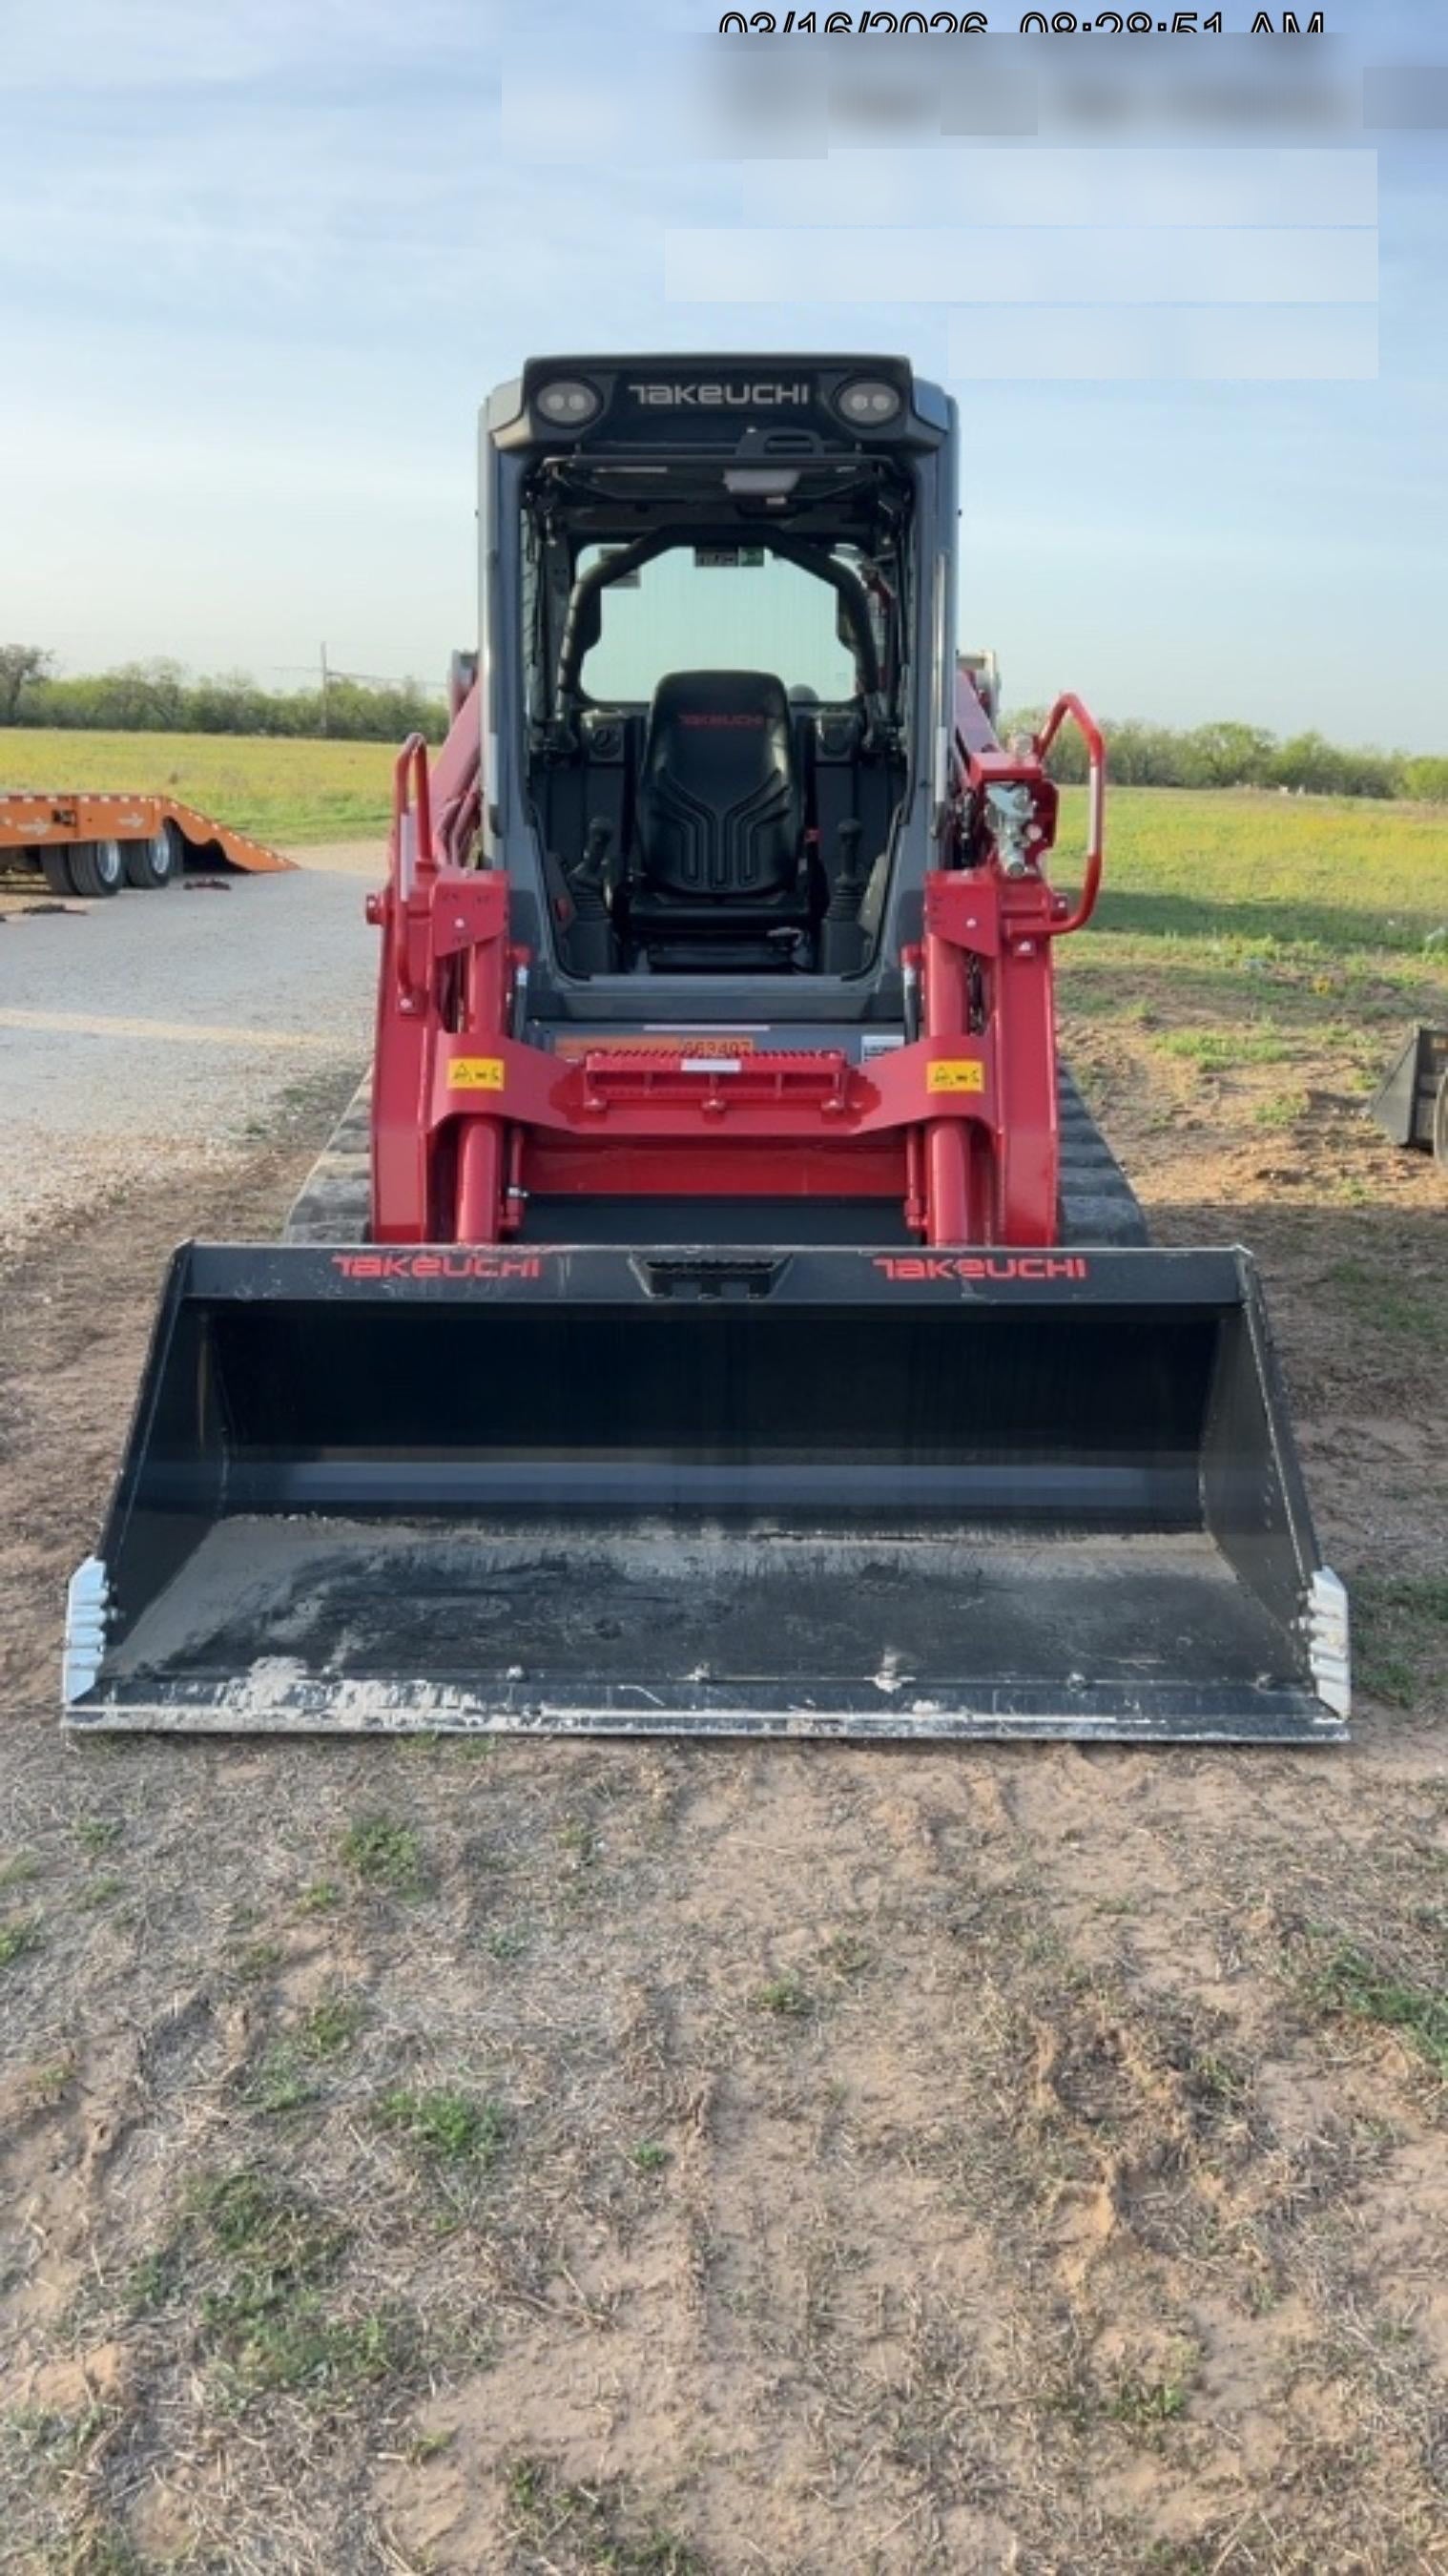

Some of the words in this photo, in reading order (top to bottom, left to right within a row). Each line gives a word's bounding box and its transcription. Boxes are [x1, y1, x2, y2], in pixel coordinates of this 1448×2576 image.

[628, 384, 808, 405] TAKEUCHI
[331, 1255, 541, 1278] TAKEUCHI
[872, 1257, 1087, 1279] TAKEUCHI
